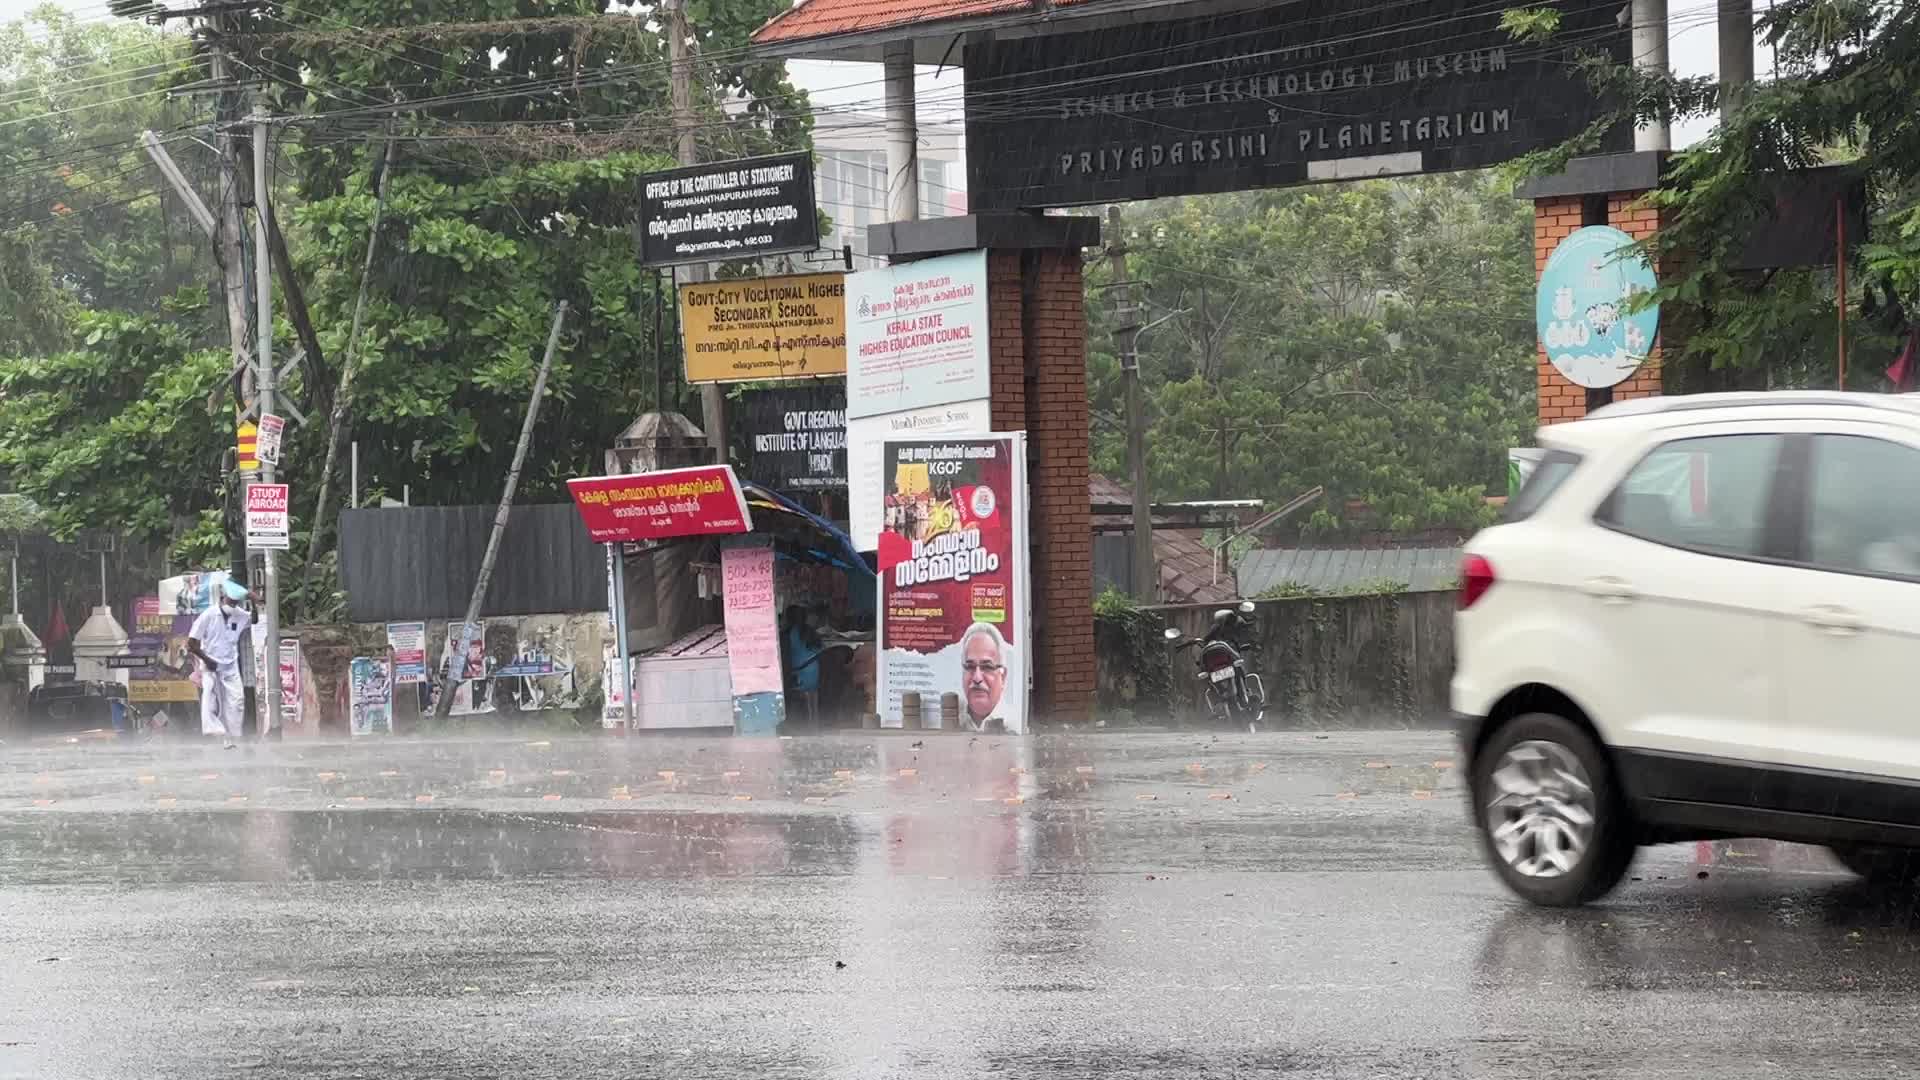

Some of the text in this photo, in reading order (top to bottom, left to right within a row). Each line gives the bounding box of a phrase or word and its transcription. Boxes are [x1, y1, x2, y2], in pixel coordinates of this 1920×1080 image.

[1060, 90, 1155, 120] SCIENCE
[1203, 63, 1375, 104] TECHNOLOGY
[1394, 47, 1508, 83] MUSEUM
[1267, 108, 1280, 123] &
[1061, 108, 1509, 175] PRIYADARSINI PLANETARIUM
[646, 180, 670, 200] OFFICE
[670, 179, 680, 197] OF
[681, 177, 695, 195] THE
[694, 170, 739, 192] CONTROLLER
[751, 164, 794, 184] STATIONERY
[743, 285, 803, 302] VOCATIONAL
[714, 302, 818, 322] SECONDARY SCHOOL
[886, 313, 943, 337] KERALA STATE
[859, 324, 972, 358] HIGHER EDUCATION COUNCIL
[756, 433, 796, 453] INSTITUTE
[797, 432, 808, 451] OF
[929, 461, 963, 475] KGOF
[248, 499, 286, 509] ABROAD
[252, 488, 281, 498] STUDY
[912, 528, 980, 560] സംസ്ഥാന
[895, 547, 999, 587] സമ്മേളനം
